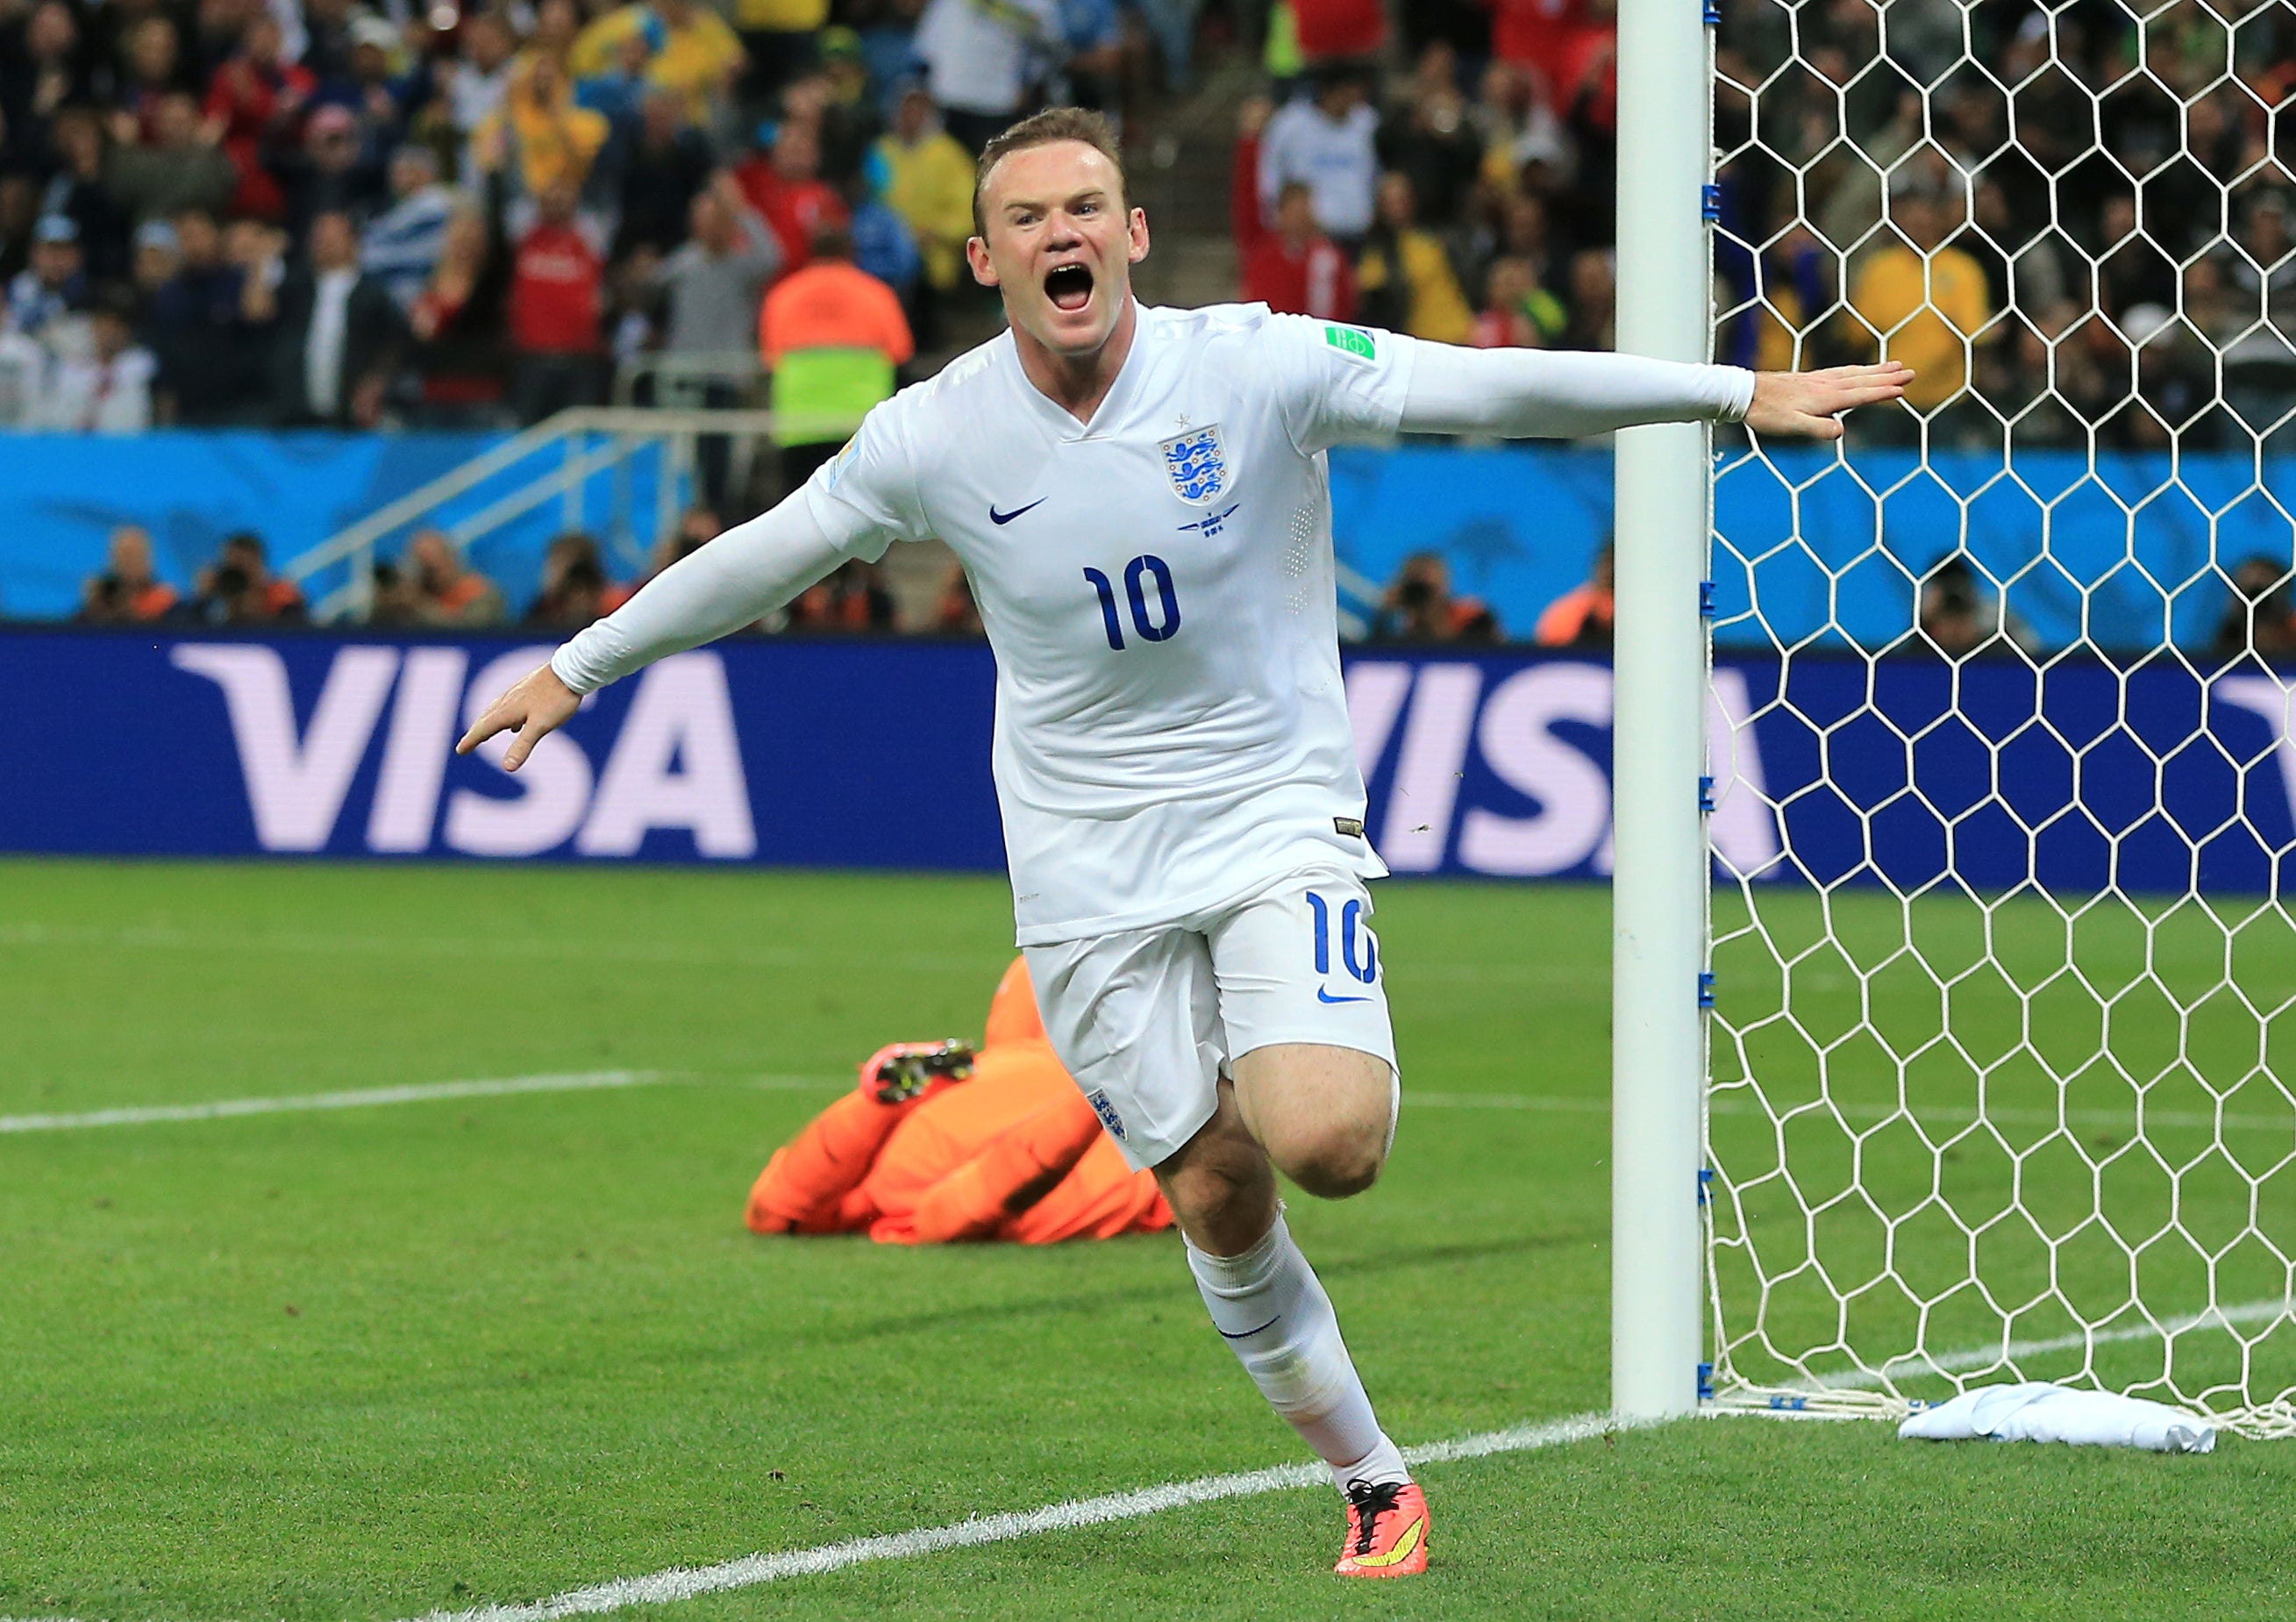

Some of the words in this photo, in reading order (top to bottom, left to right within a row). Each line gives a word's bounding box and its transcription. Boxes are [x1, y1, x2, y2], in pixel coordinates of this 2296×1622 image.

[1082, 554, 1180, 651] 10
[173, 642, 758, 857] VISA
[1344, 661, 1780, 879] IS
[1306, 890, 1376, 983] 10
